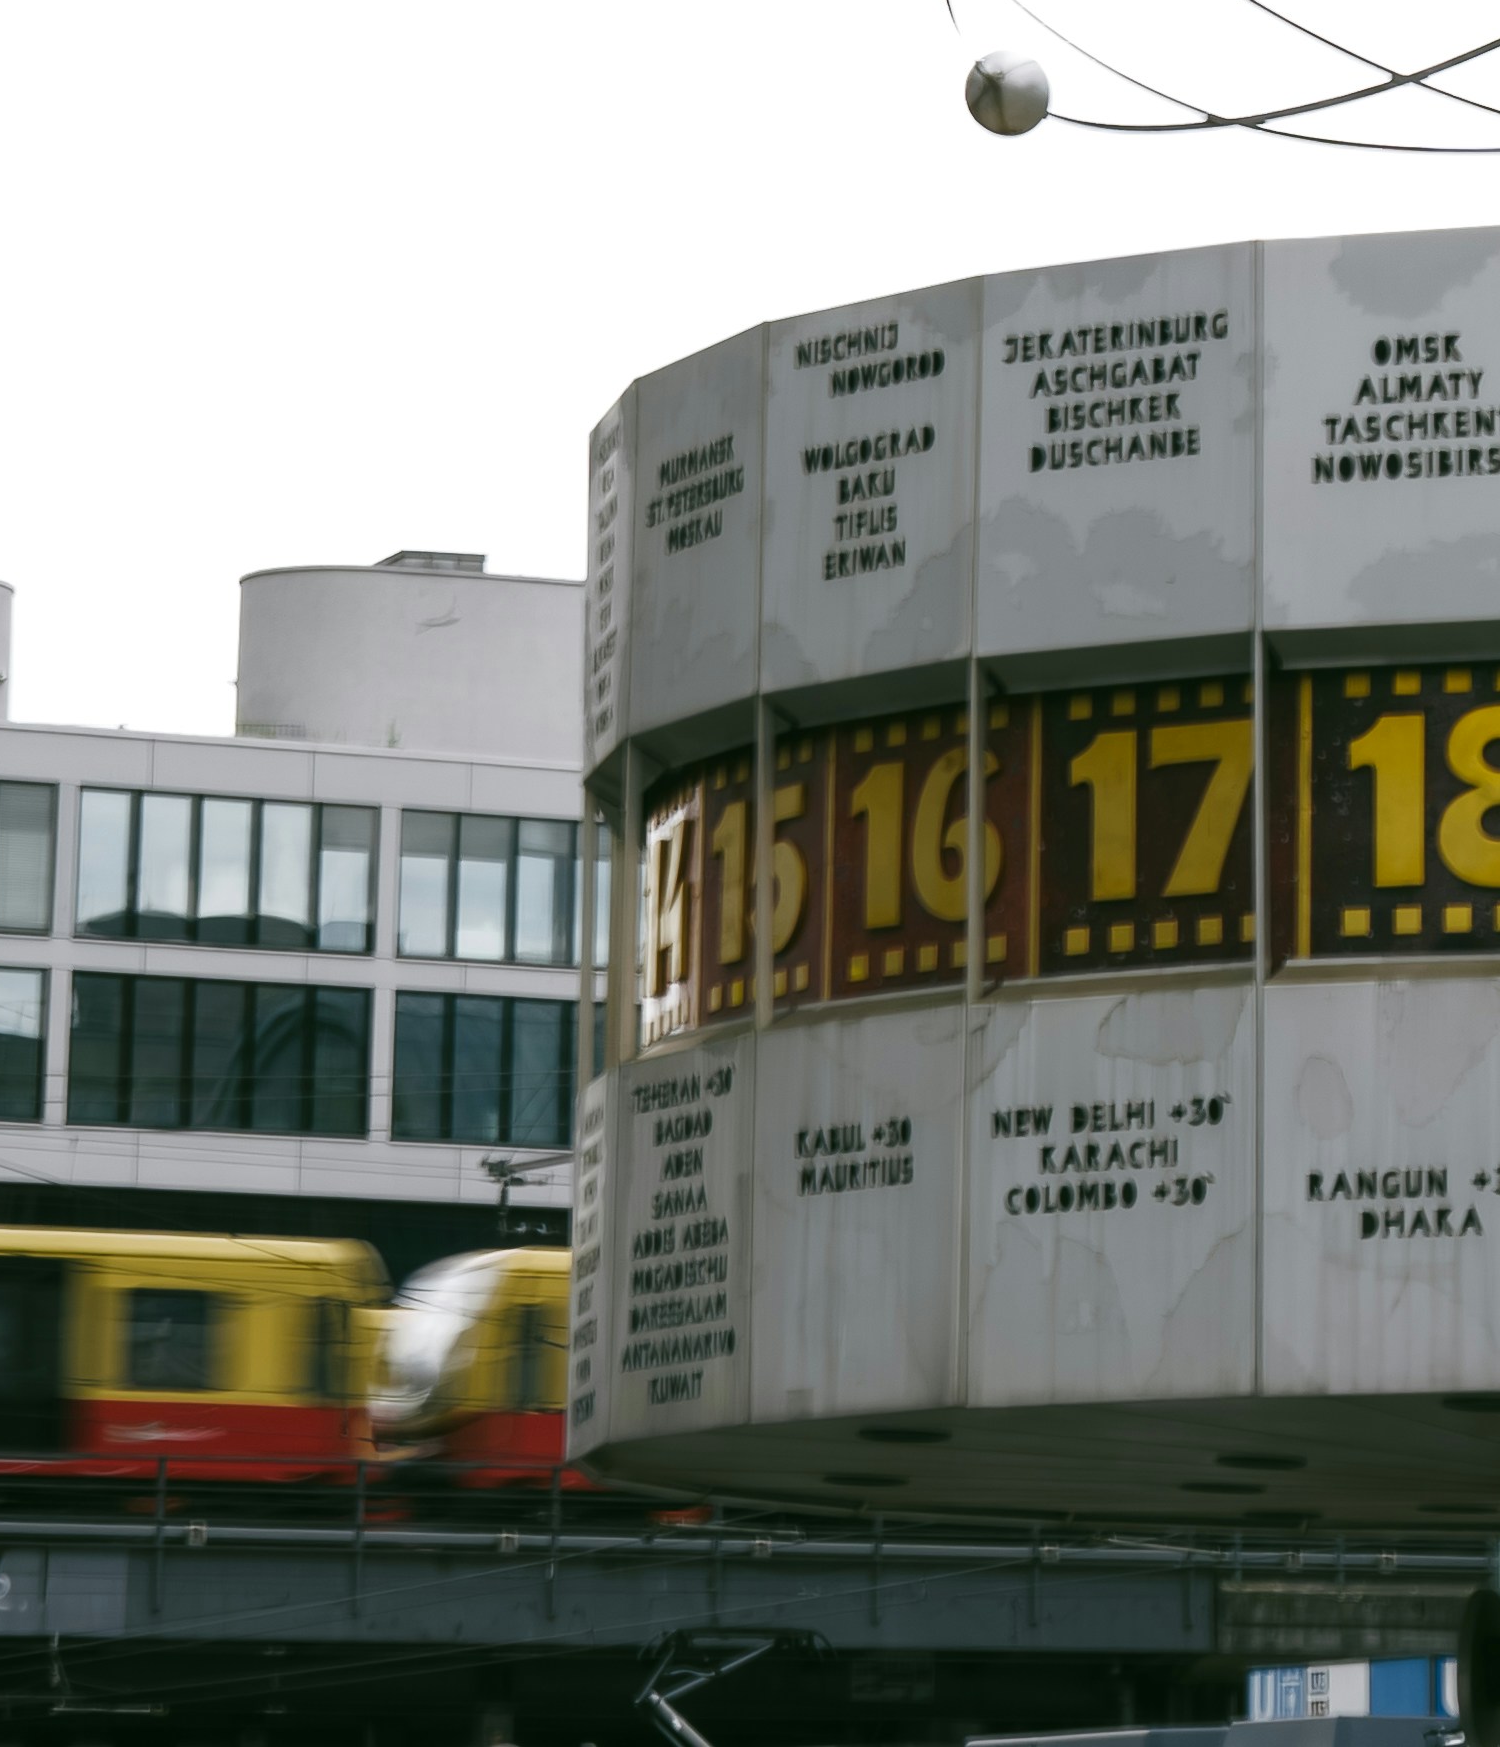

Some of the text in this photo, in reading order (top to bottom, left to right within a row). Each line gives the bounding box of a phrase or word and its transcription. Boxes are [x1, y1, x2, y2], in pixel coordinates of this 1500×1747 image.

[795, 320, 899, 369] NISCHNIJ
[1002, 307, 1229, 364] JEKATERINBURG
[1369, 331, 1463, 367] OMSK
[829, 349, 946, 398] NOWGOROD
[1029, 350, 1202, 399] ASCHGABAT
[1353, 369, 1484, 406] ALMATY
[1045, 391, 1182, 434] BISCHKEK
[803, 423, 936, 475] WOLGOGRAD
[1028, 425, 1201, 473] DUSCHANBE
[837, 467, 896, 505] BAKU
[665, 509, 723, 556] MOSKAU
[833, 502, 898, 540] TIFLIS
[822, 538, 906, 580] ERIWAN
[1069, 719, 1254, 902] 17
[850, 749, 1004, 931] 16
[712, 782, 808, 966] 15
[653, 1108, 713, 1147] BAGDAD
[794, 1121, 866, 1159] KABUL
[990, 1105, 1053, 1140] NEW
[1069, 1099, 1155, 1134] DELHI
[660, 1147, 702, 1182] ADEN
[797, 1152, 913, 1197] MAURITIUS
[1039, 1137, 1179, 1175] KARACHI
[652, 1185, 707, 1220] SANAA
[1004, 1177, 1138, 1216] COLOMBO
[1306, 1167, 1449, 1203] RANGUN
[1359, 1205, 1483, 1240] DHAKA
[647, 1370, 703, 1405] KUWAIT
